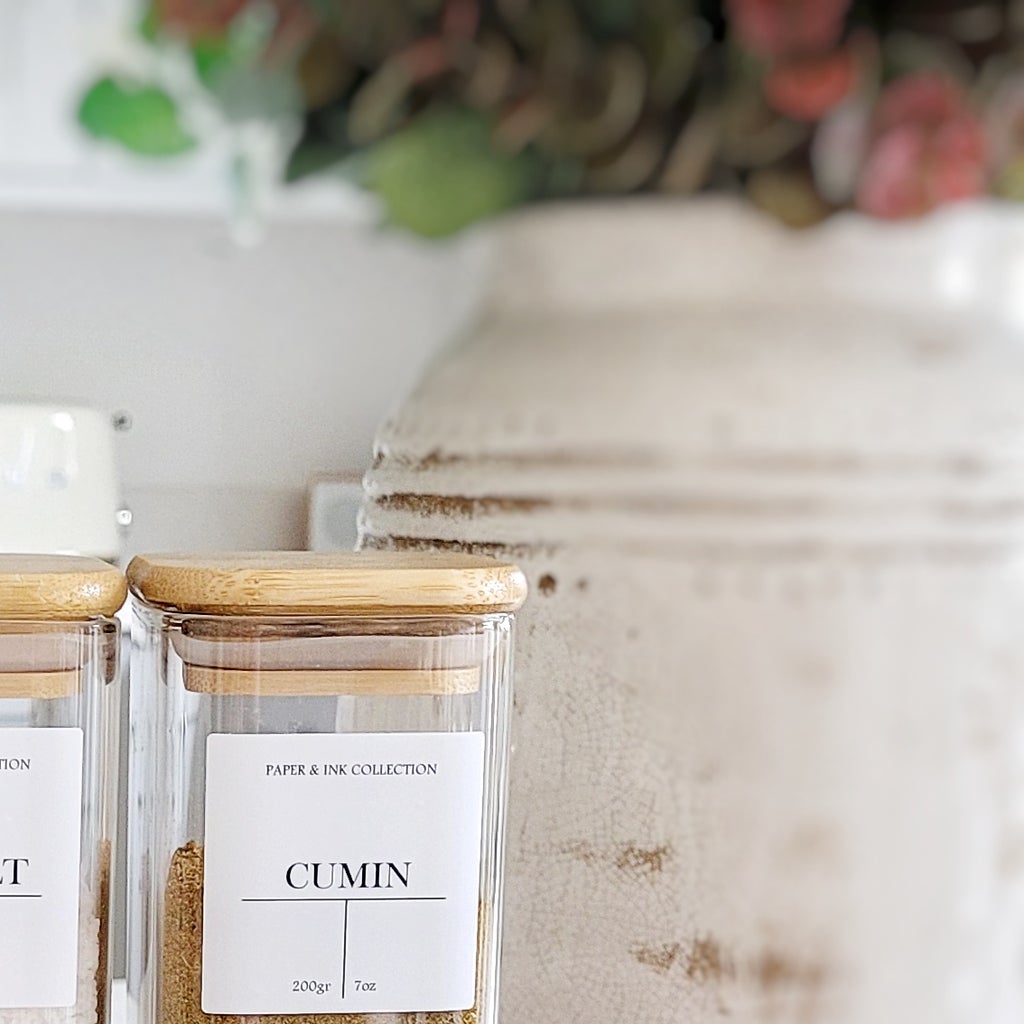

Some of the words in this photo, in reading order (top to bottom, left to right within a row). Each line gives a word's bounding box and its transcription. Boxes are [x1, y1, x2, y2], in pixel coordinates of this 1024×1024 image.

[266, 764, 306, 776] PAPER
[309, 764, 319, 776] &
[323, 764, 348, 776] INK
[351, 763, 438, 776] COLLECTION
[285, 861, 412, 890] CUMIN
[292, 980, 331, 995] 200gr
[354, 980, 377, 992] 7oz
